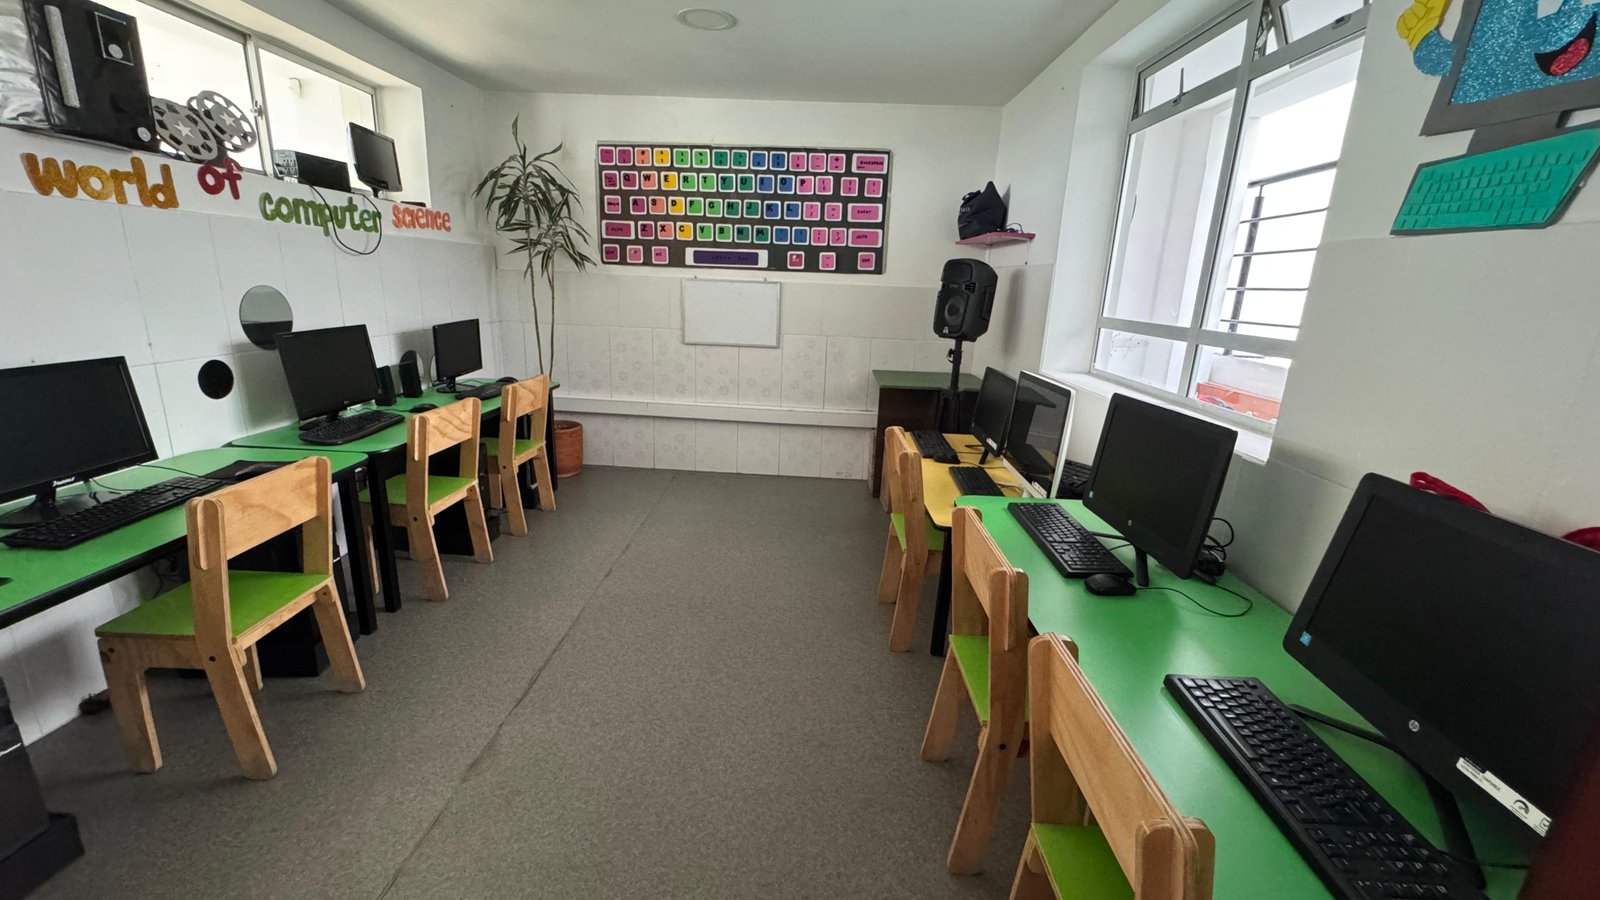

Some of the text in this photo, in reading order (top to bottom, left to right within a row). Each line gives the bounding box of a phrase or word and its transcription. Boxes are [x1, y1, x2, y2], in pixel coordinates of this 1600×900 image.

[198, 158, 244, 200] of
[260, 192, 382, 237] computer
[392, 204, 452, 232] science
